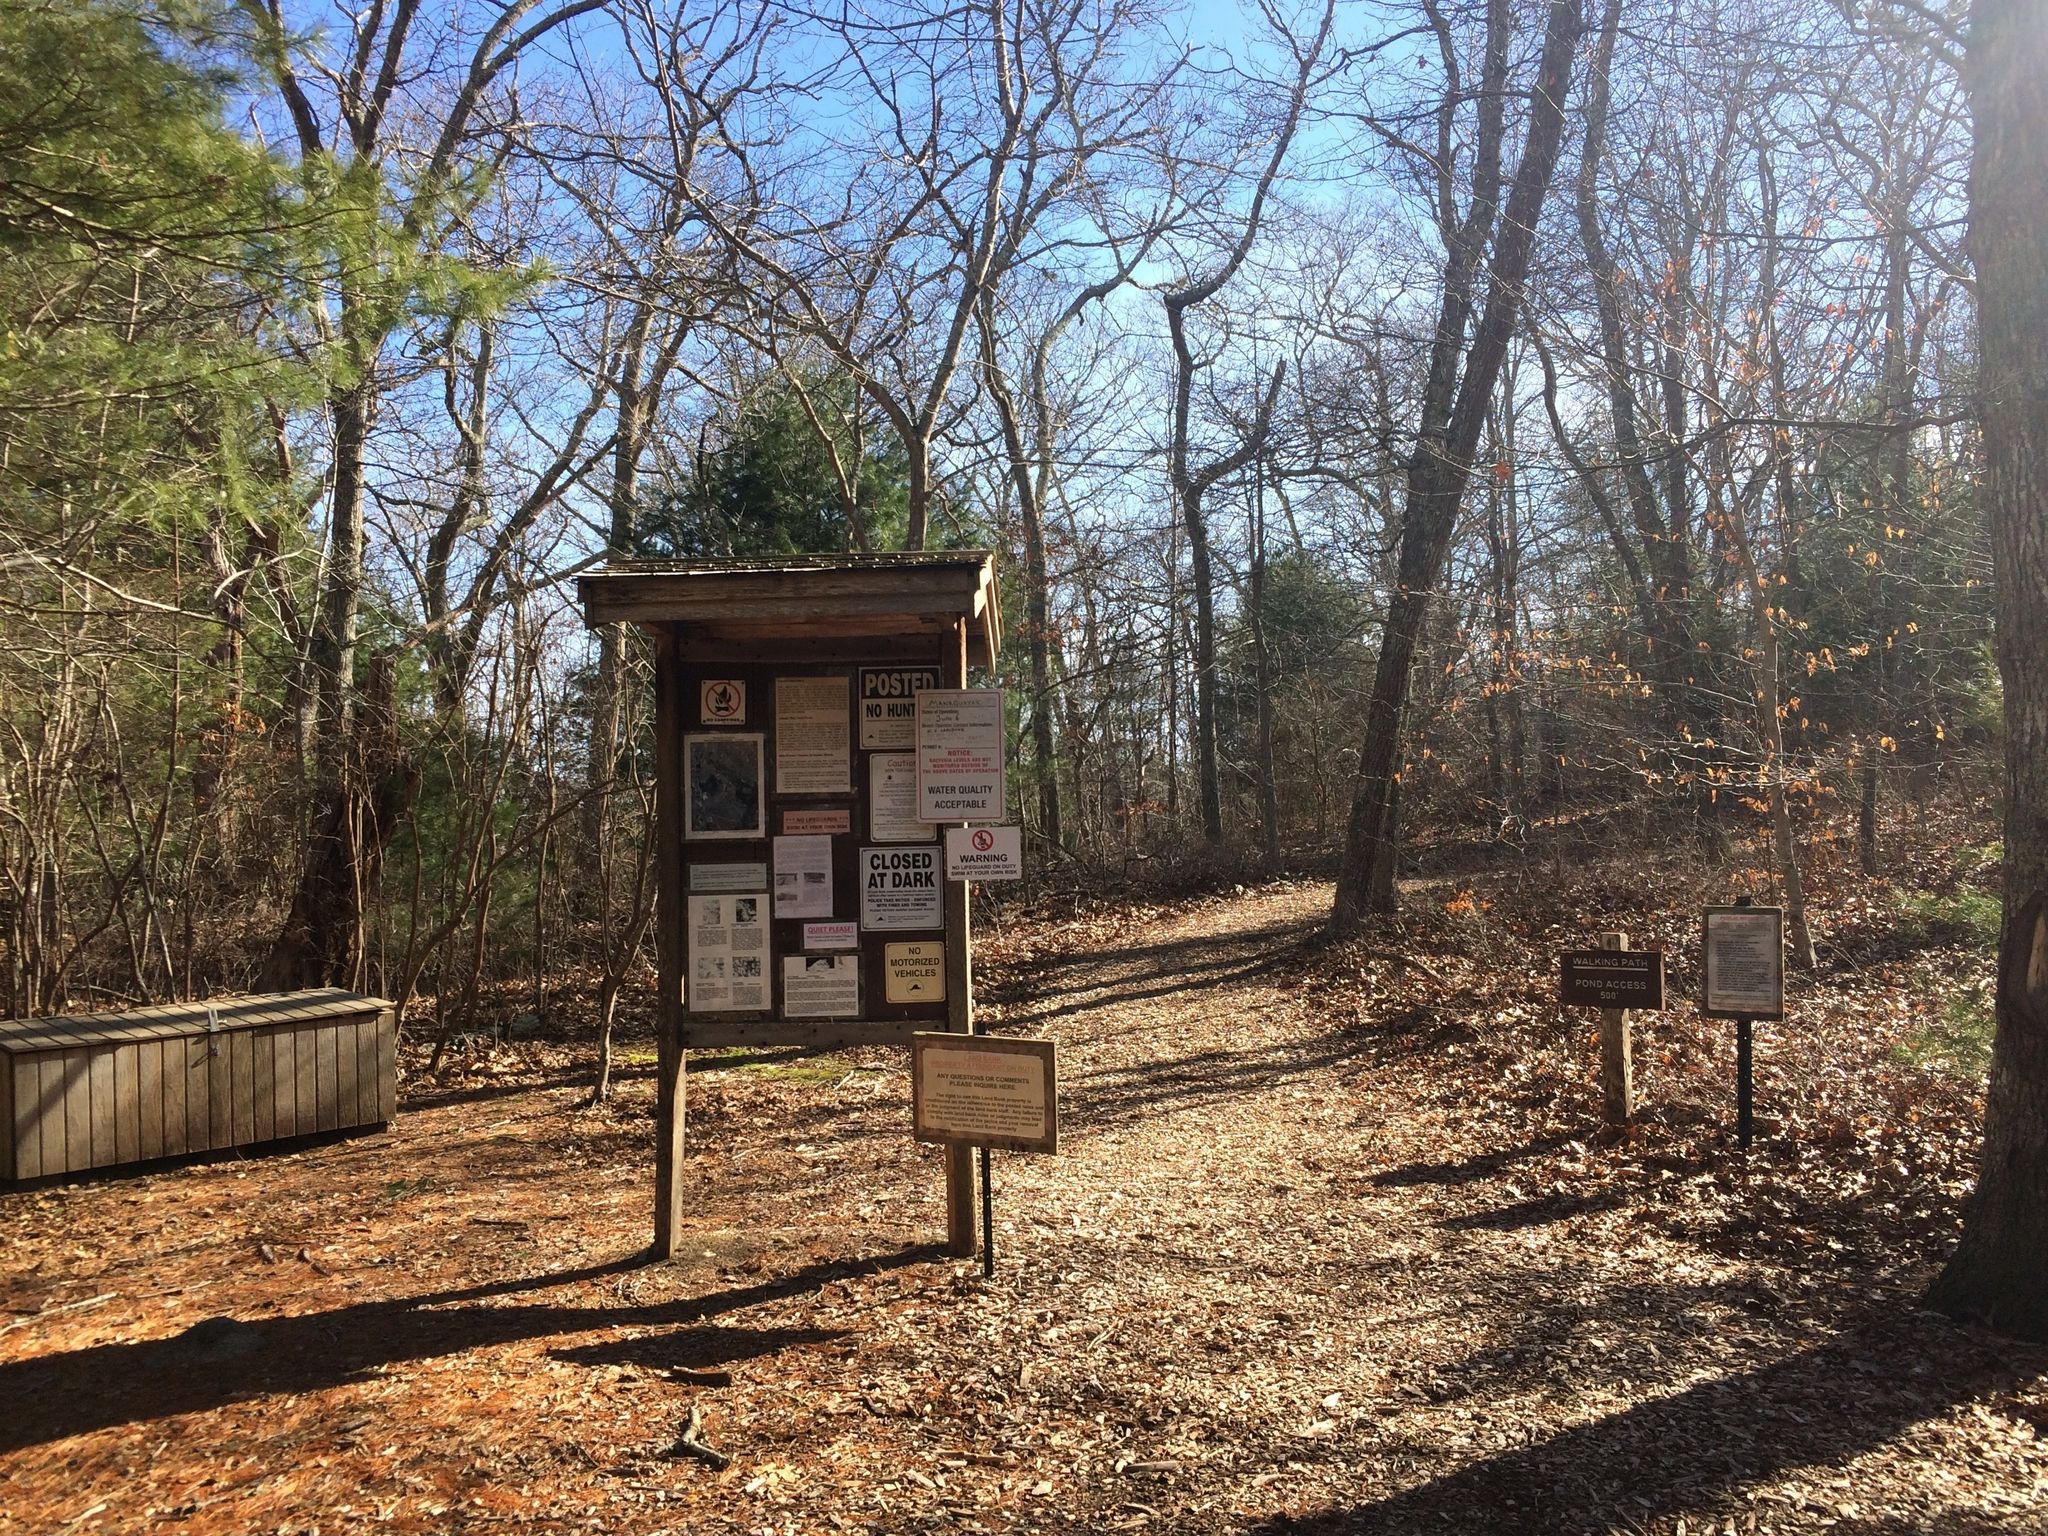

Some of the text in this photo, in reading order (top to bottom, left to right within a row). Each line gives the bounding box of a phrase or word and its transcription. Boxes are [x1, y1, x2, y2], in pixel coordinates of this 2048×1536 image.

[865, 672, 935, 696] POSTED
[866, 703, 916, 717] NO HUNT
[928, 785, 993, 795] WATER QUALITY
[934, 800, 987, 809] ACCEPTABLE
[870, 853, 932, 870] CLOSED
[960, 854, 1008, 863] WARNING
[868, 872, 935, 889] AT DARK
[808, 926, 827, 935] QUIET
[909, 947, 921, 955] NO
[890, 957, 940, 967] MOTORIZED
[1573, 957, 1648, 968] WALKING PATH
[894, 968, 936, 977] VEHICLES
[1575, 979, 1647, 990] POND ACCESS
[950, 1074, 985, 1082] QUESTIONS
[995, 1076, 1030, 1084] COMMENTS
